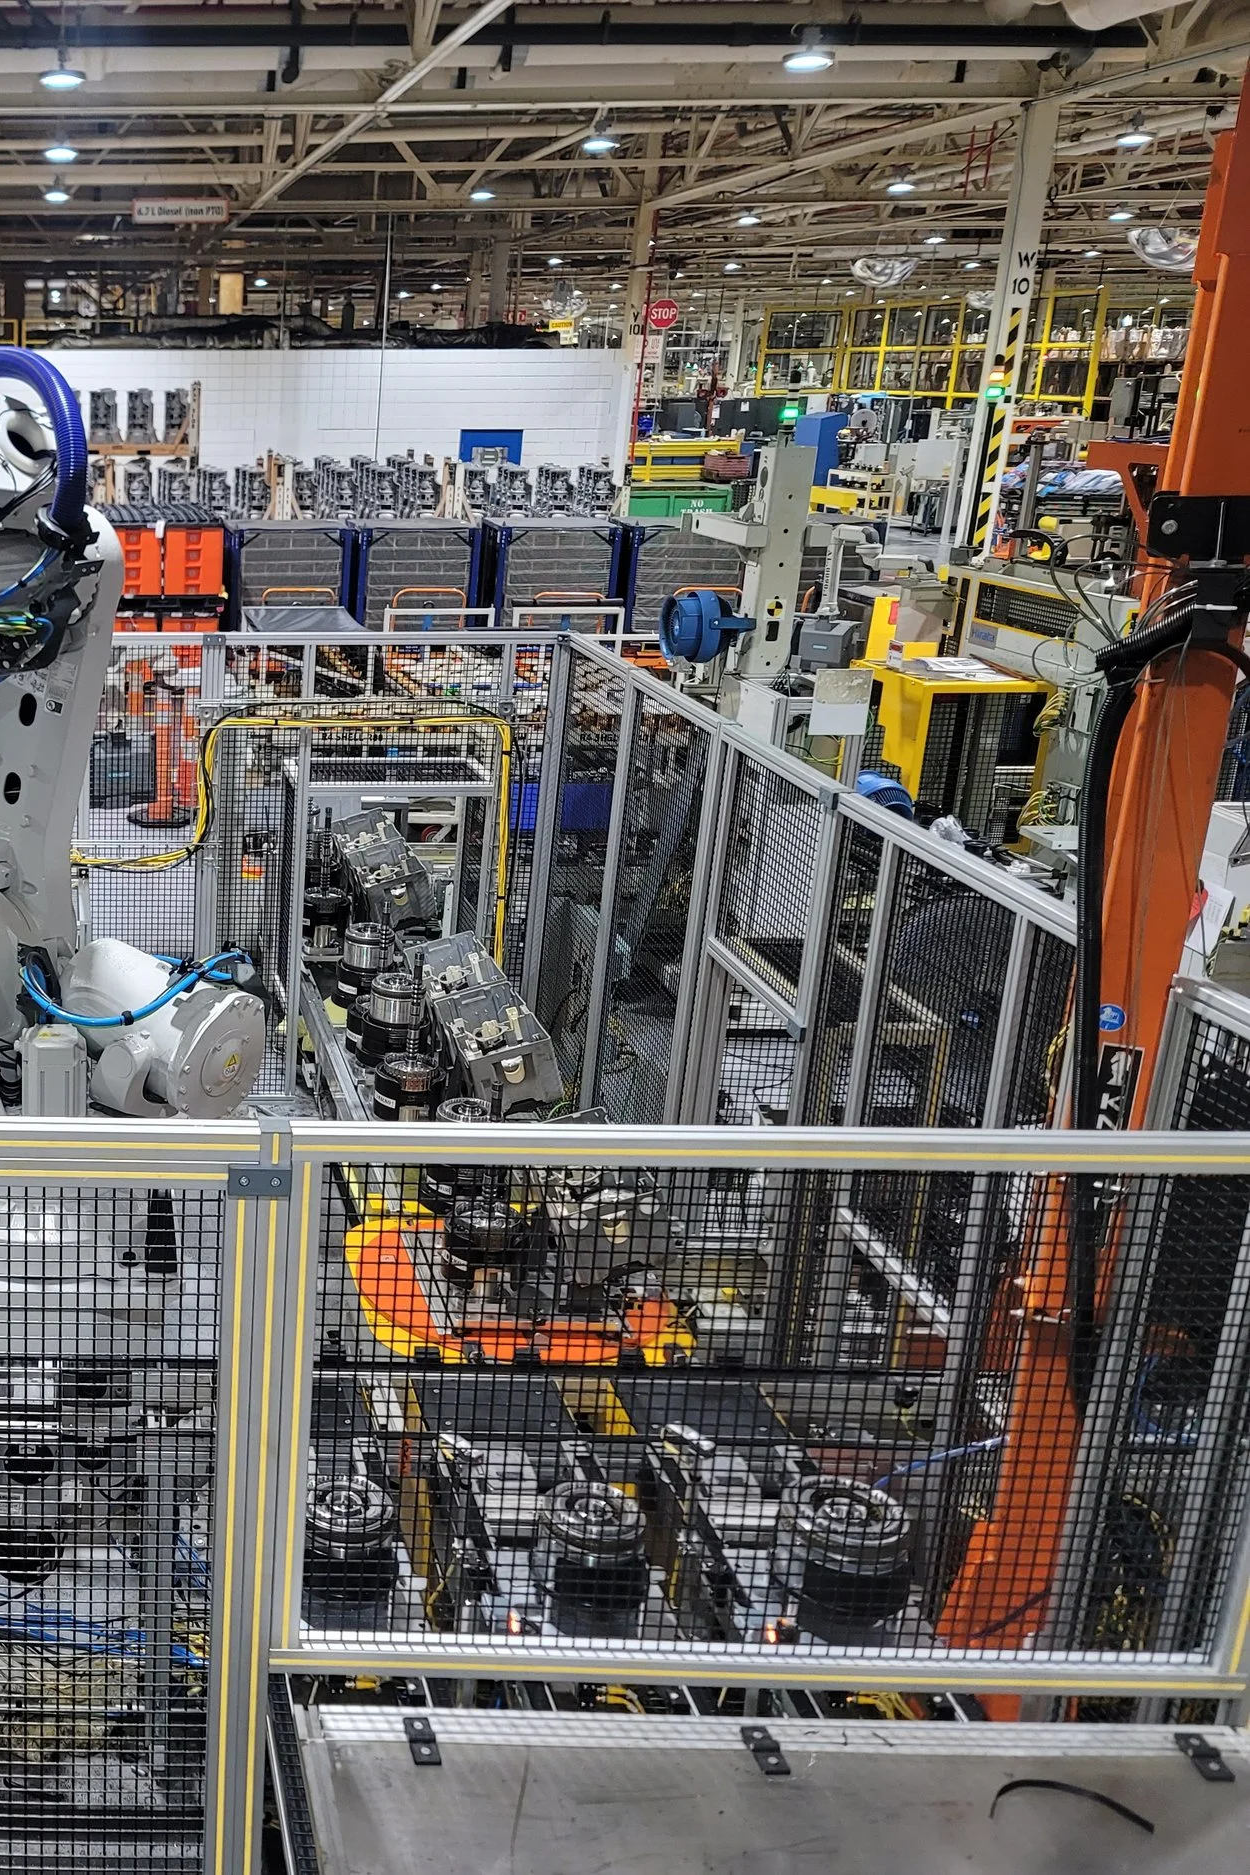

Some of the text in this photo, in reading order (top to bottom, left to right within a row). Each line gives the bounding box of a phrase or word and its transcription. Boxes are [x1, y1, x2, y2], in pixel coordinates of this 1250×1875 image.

[158, 206, 182, 216] Diesel
[205, 206, 224, 217] PTO)
[1018, 251, 1037, 268] W
[1012, 277, 1030, 295] 10
[633, 311, 639, 323] Y
[650, 307, 677, 320] STOP
[551, 321, 573, 329] CAUTION
[690, 499, 704, 508] NO
